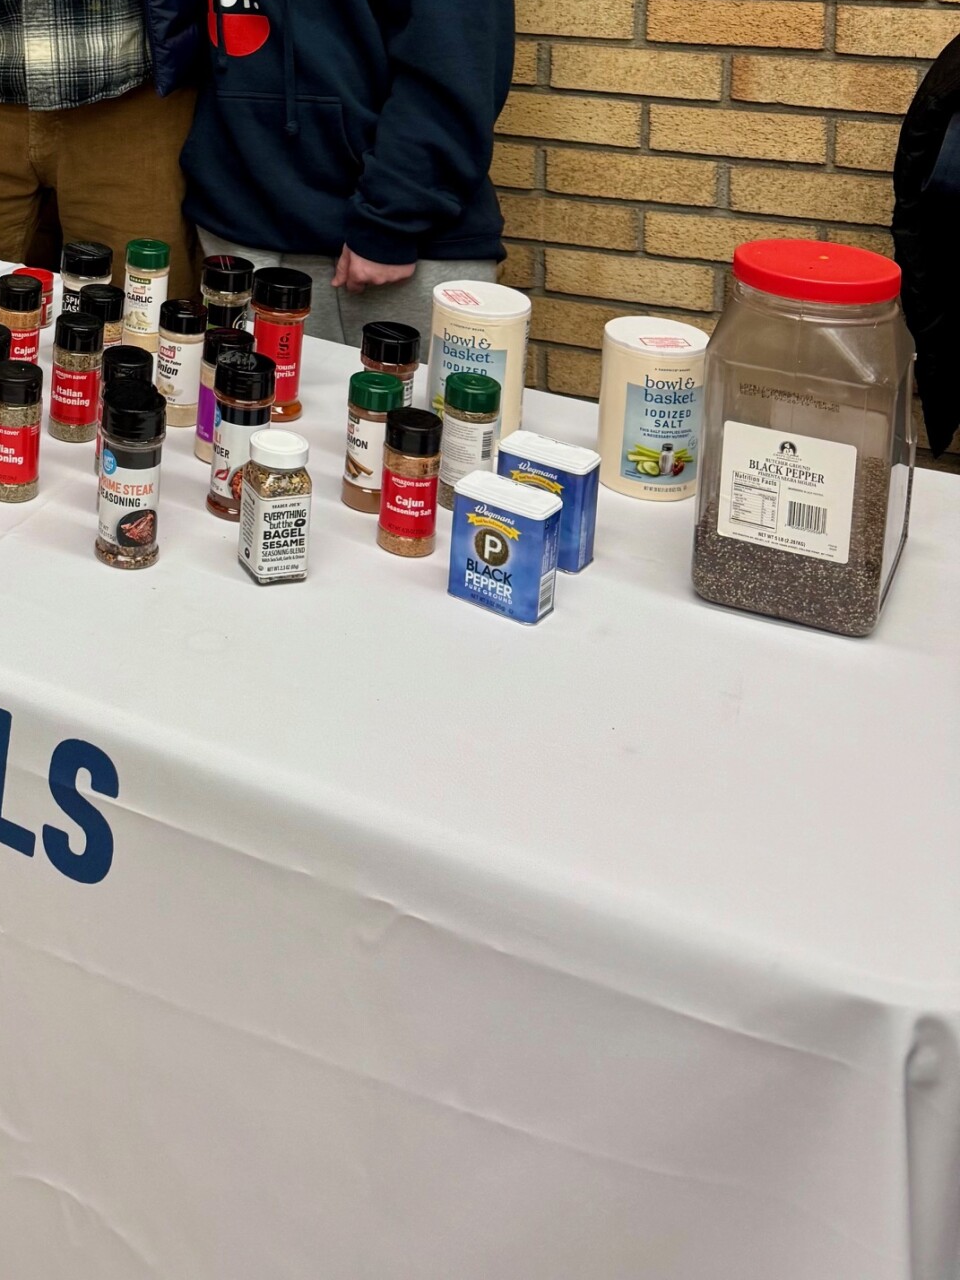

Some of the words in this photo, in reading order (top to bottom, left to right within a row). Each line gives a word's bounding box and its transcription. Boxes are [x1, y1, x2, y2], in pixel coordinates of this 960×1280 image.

[127, 292, 153, 303] GARLIC
[444, 328, 476, 349] bowl
[478, 337, 492, 351] &
[14, 346, 35, 357] Cajun
[443, 342, 491, 364] basket
[276, 371, 295, 379] prika
[443, 360, 487, 376] IODIZED
[645, 375, 683, 390] bowl
[684, 377, 695, 390] &
[57, 385, 83, 397] Italian
[644, 389, 694, 405] basket
[645, 408, 691, 418] IODIZED
[654, 419, 683, 428] SALT
[347, 436, 368, 451] AMON
[518, 461, 558, 480] Wegmans
[749, 459, 783, 476] BLACK
[785, 468, 825, 484] PEPPER
[391, 476, 414, 488] amazon
[415, 480, 431, 488] saver
[735, 472, 760, 483] Nutrition
[761, 478, 777, 486] Facts
[123, 483, 154, 496] STEAK
[386, 501, 419, 517] Seasoning
[420, 509, 432, 517] Salt
[395, 495, 425, 509] Cajun
[263, 509, 307, 521] EVERYTHING
[474, 503, 515, 525] Wegmans
[269, 520, 282, 529] but
[281, 520, 293, 528] the
[263, 528, 305, 540] BAGEL
[262, 538, 305, 550] SESAME
[484, 533, 502, 560] P
[261, 549, 289, 558] SEASONING
[289, 547, 306, 555] BLEND
[466, 558, 513, 587] BLACK
[465, 570, 513, 599] PEPPER
[464, 583, 481, 592] PURE
[482, 590, 513, 604] GROUND
